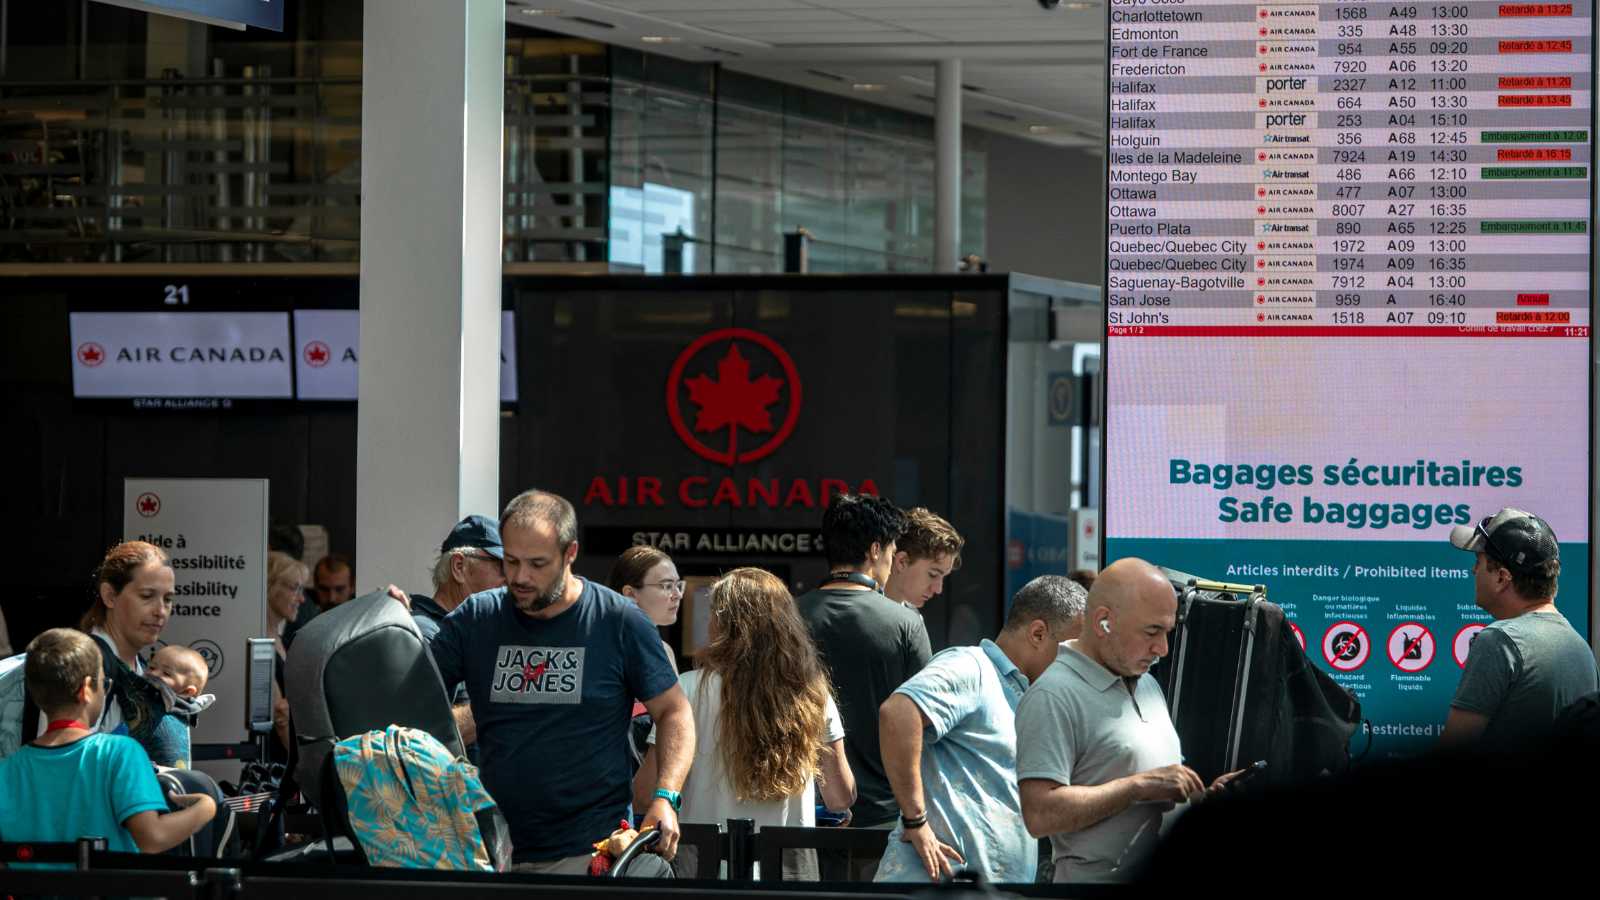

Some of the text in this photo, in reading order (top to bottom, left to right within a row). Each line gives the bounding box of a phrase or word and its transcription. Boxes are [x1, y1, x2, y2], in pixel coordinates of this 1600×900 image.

[1112, 10, 1202, 22] Charlottetown
[1336, 8, 1367, 19] 1568
[1432, 7, 1468, 17] 13:00
[1112, 28, 1178, 40] Edmonton
[1339, 25, 1362, 37] 335
[1432, 24, 1467, 35] 13:30
[1112, 46, 1138, 58] Fort
[1142, 46, 1158, 57] de
[1162, 45, 1208, 56] France
[1338, 43, 1361, 55] 954
[1431, 42, 1467, 53] 09:20
[1112, 64, 1186, 75] Fredericton
[1335, 61, 1366, 72] 7920
[1432, 60, 1467, 71] 13:20
[1111, 82, 1156, 94] Halifax
[1266, 77, 1307, 93] porter
[1334, 79, 1366, 91] 2327
[1432, 78, 1466, 89] 11:00
[1111, 99, 1156, 111] Halifax
[1338, 97, 1361, 108] 664
[1431, 96, 1467, 107] 13:30
[1111, 117, 1156, 128] Halifax
[1266, 112, 1306, 128] porter
[1337, 115, 1362, 126] 253
[1431, 114, 1467, 125] 15:10
[1111, 134, 1160, 149] Holguin
[1272, 135, 1284, 143] Air
[1285, 135, 1309, 143] transat
[1338, 133, 1361, 144] 356
[1431, 132, 1467, 143] 12:45
[1111, 152, 1134, 164] Iles
[1138, 152, 1154, 164] de
[1158, 152, 1169, 164] la
[1174, 152, 1242, 164] Madeleine
[1333, 151, 1365, 162] 7924
[1432, 150, 1466, 161] 14:30
[1110, 170, 1168, 184] Montego
[1172, 170, 1198, 184] Bay
[1272, 171, 1284, 179] Air
[1337, 169, 1361, 180] 486
[1431, 168, 1466, 179] 12:10
[1110, 188, 1157, 200] Ottawa
[1336, 187, 1360, 198] 477
[1431, 186, 1466, 197] 13:00
[1110, 206, 1156, 217] Ottawa
[1333, 204, 1365, 216] 8007
[1431, 204, 1466, 215] 16:35
[1110, 223, 1152, 235] Puerto
[1157, 222, 1191, 234] Plata
[1337, 223, 1360, 233] 890
[1431, 222, 1466, 233] 12:25
[1110, 240, 1218, 252] Quebec/Quebec
[1221, 240, 1247, 255] City
[1333, 240, 1364, 252] 1972
[1430, 240, 1465, 251] 13:00
[1110, 258, 1218, 271] Quebec/Quebec
[1220, 258, 1247, 273] City
[1334, 258, 1364, 270] 1974
[1430, 258, 1465, 270] 16:35
[1110, 276, 1245, 291] Saguenay-Bagotville
[1332, 276, 1364, 288] 7912
[1430, 276, 1465, 287] 13:00
[164, 286, 190, 304] 21
[1110, 294, 1465, 306] San Jose 959 A 16:40
[1110, 312, 1123, 324] St
[1126, 312, 1169, 324] John's
[1333, 312, 1364, 323] 1518
[1428, 312, 1465, 323] 09:10
[1564, 328, 1588, 336] 11:21
[116, 346, 284, 362] AIR CANADA
[134, 399, 218, 408] STAR ALLIANCE
[1170, 458, 1523, 490] Bagages sécuritaires
[586, 476, 665, 506] AIR
[1218, 496, 1470, 528] Safe baggages
[176, 534, 186, 548] à
[632, 532, 810, 552] STAR ALLIANCE
[172, 554, 246, 569] essibilité
[1226, 564, 1469, 578] Articles interdits / Prohibited items
[174, 582, 238, 599] ssibility
[1312, 594, 1380, 603] Danger biologique
[1396, 604, 1427, 612] Liquides
[494, 673, 576, 693] JONES
[1390, 674, 1431, 682] Flammable
[1362, 723, 1432, 736] Restricted
